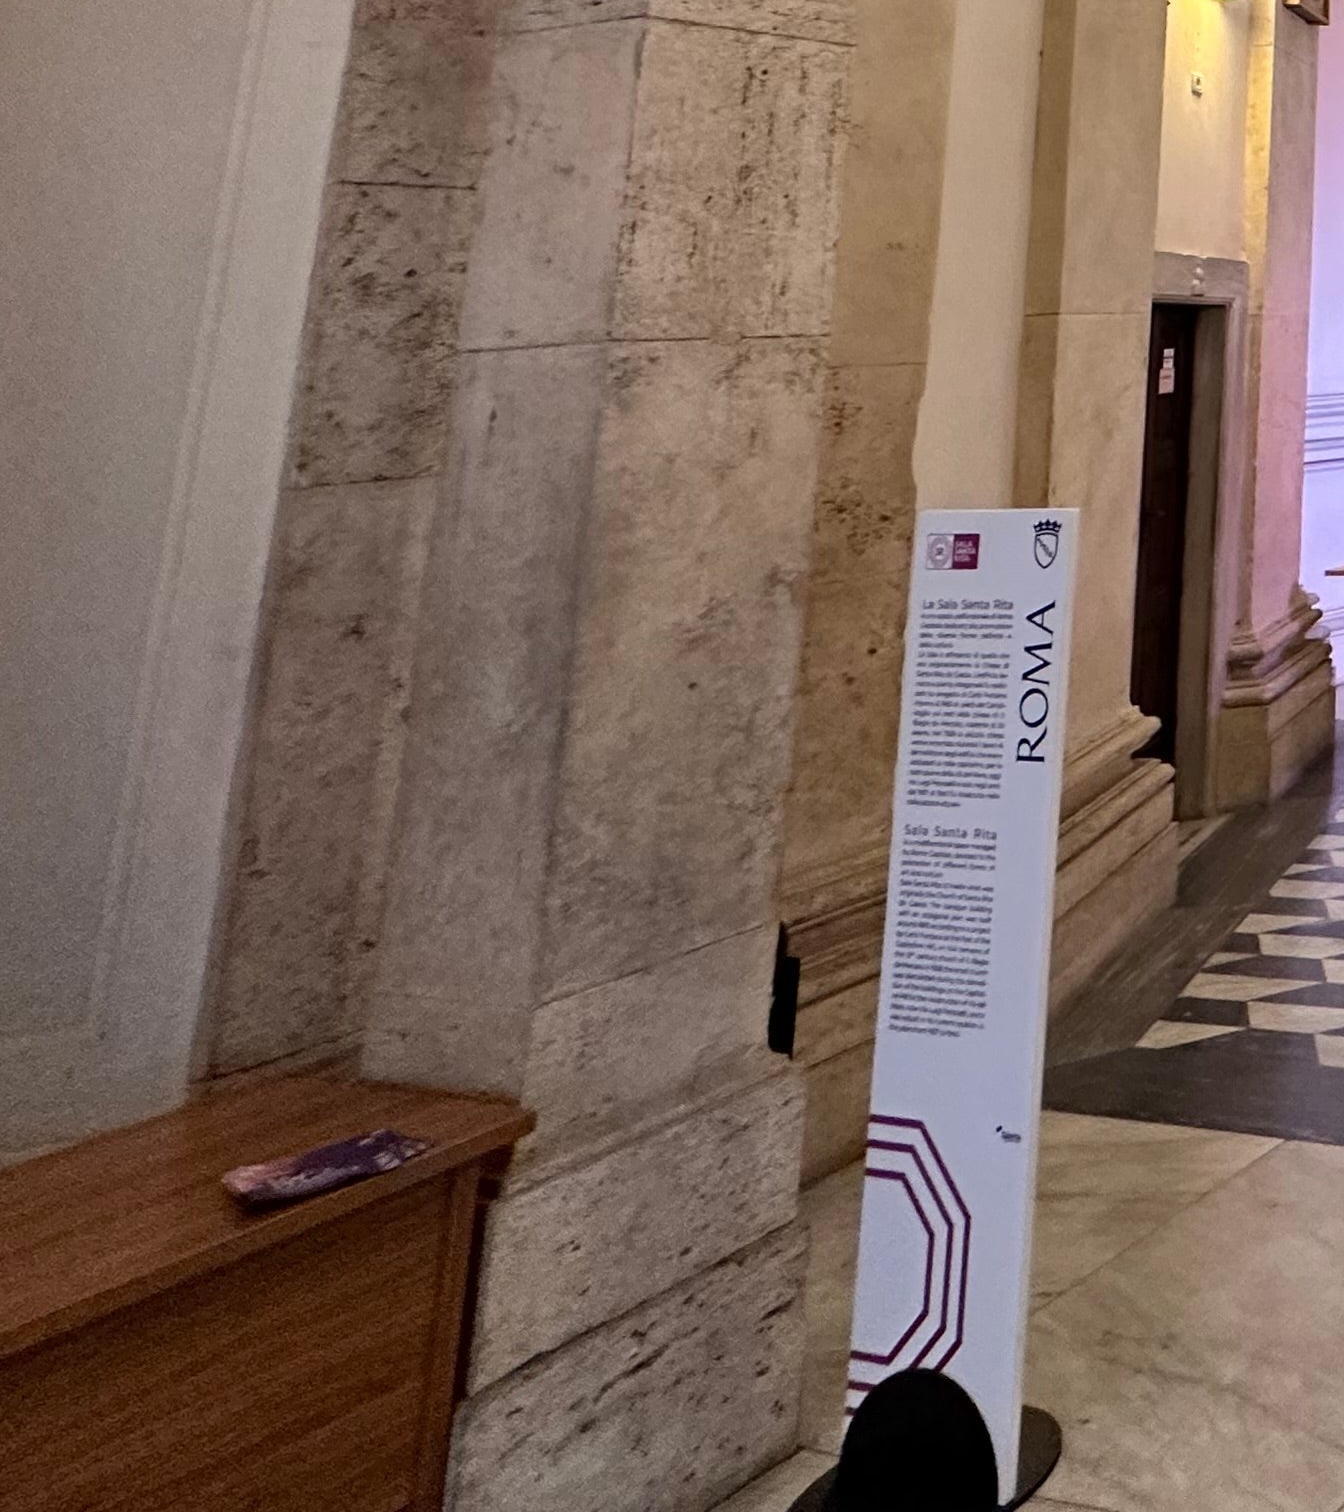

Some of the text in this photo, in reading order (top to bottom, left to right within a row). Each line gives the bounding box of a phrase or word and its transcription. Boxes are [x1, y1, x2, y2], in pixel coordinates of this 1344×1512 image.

[937, 599, 958, 609] Sala
[961, 600, 990, 610] Santa
[993, 599, 1013, 610] Rita
[1016, 600, 1056, 762] ROMA
[904, 824, 997, 840] Sala Santa Rita
